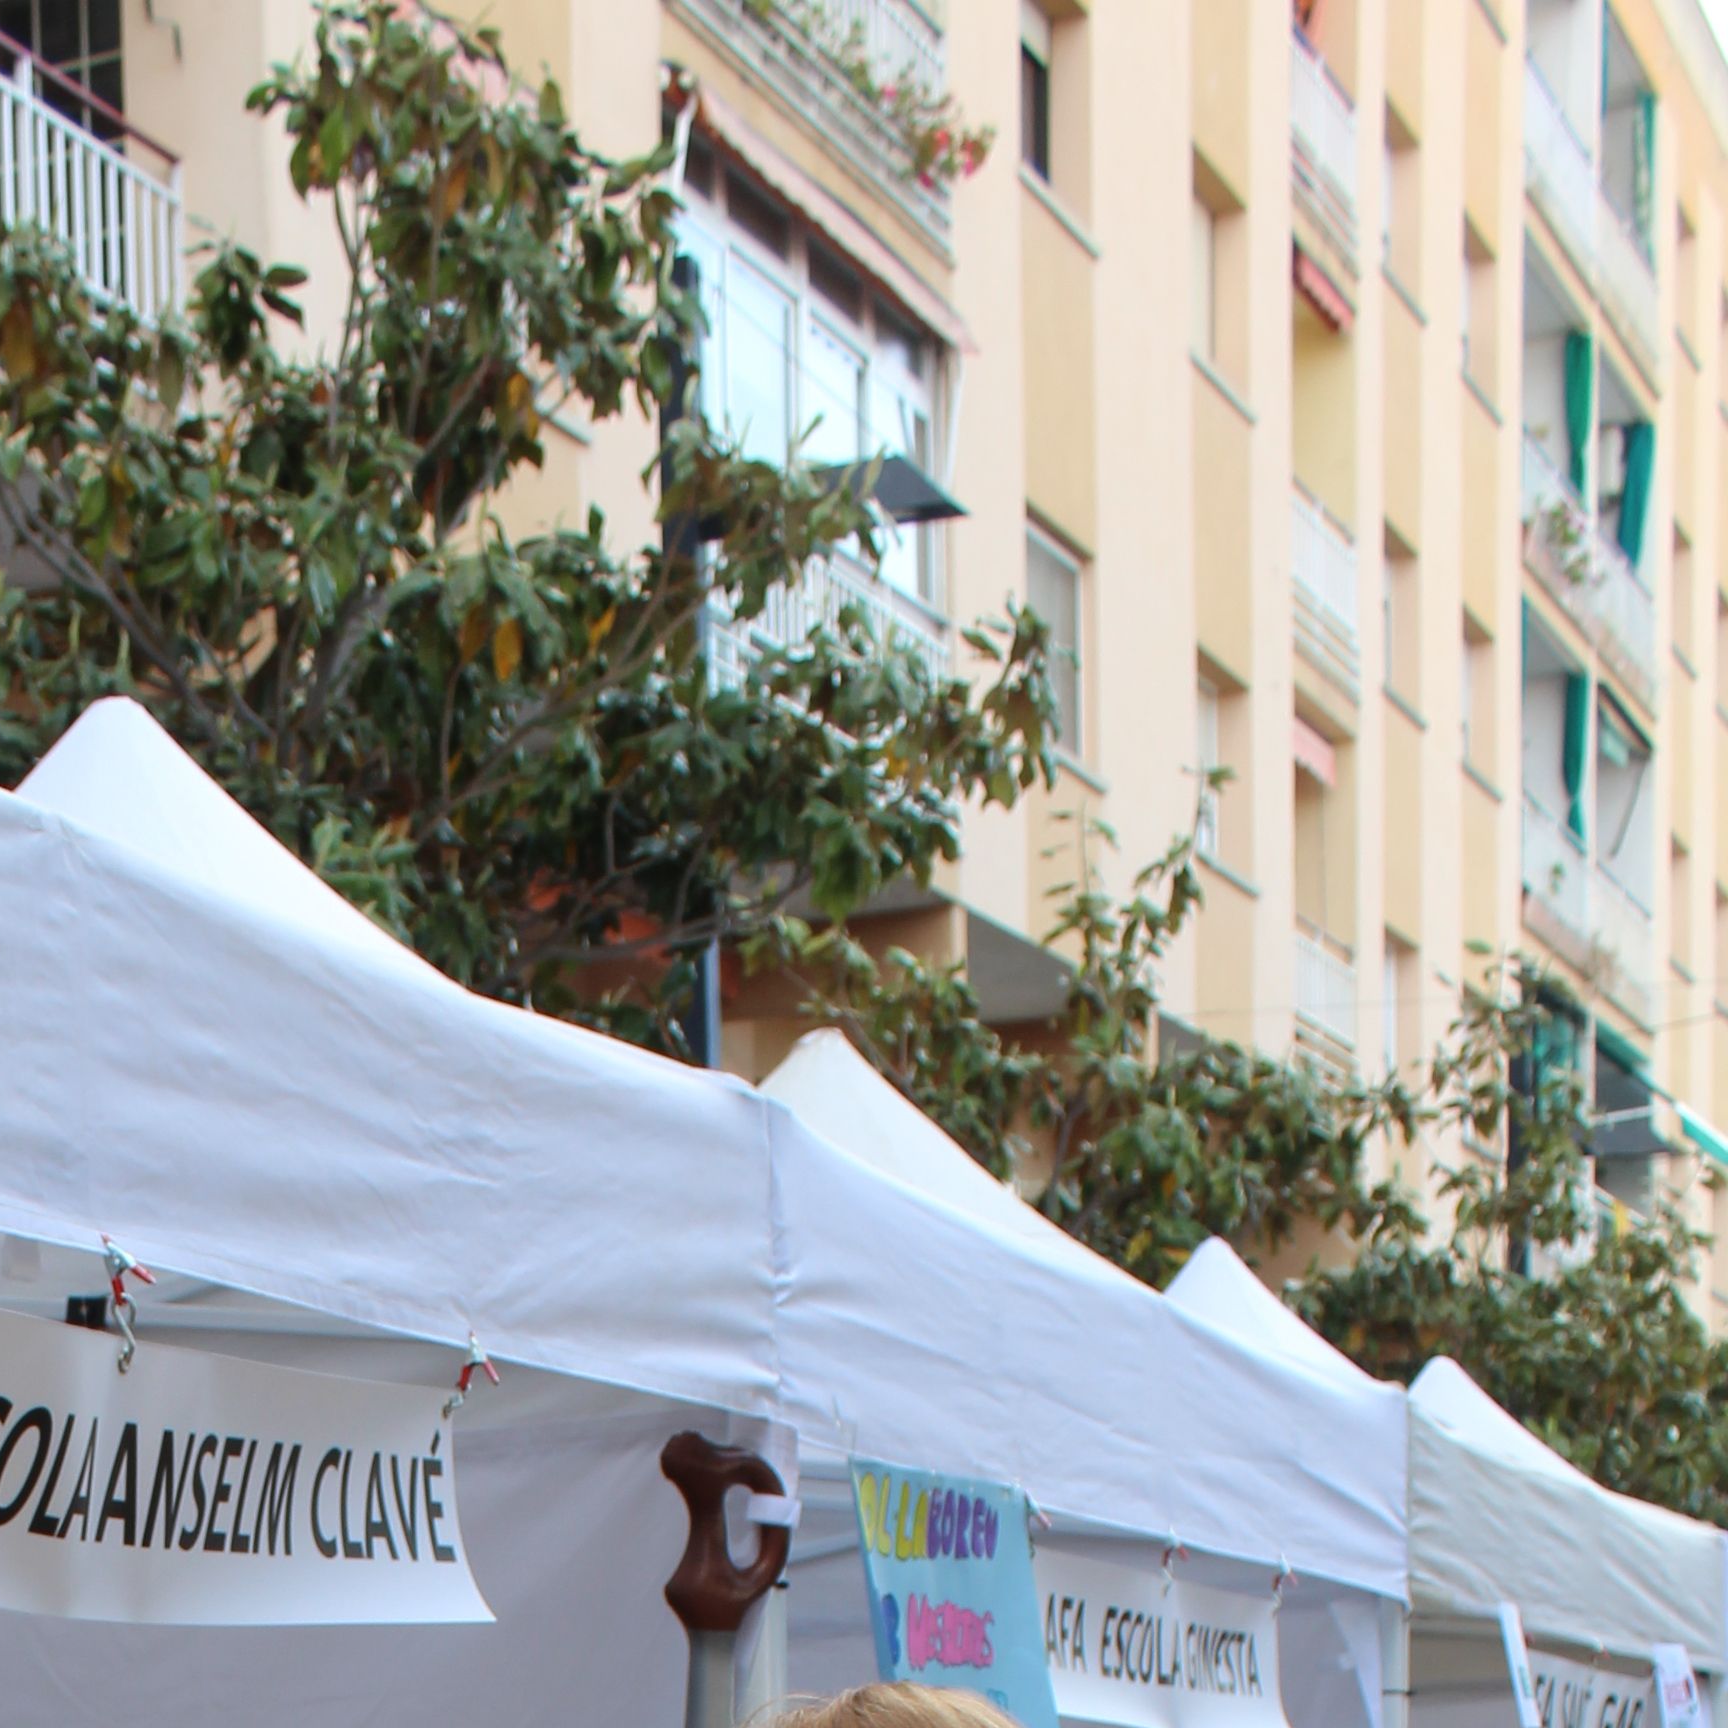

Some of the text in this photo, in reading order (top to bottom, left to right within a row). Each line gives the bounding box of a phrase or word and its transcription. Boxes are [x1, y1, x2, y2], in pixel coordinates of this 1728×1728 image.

[95, 1421, 305, 1557] ANSELM
[310, 1430, 457, 1563] CLAVÉ
[1045, 1593, 1263, 1697] AFA ESCOLA GINESTA
